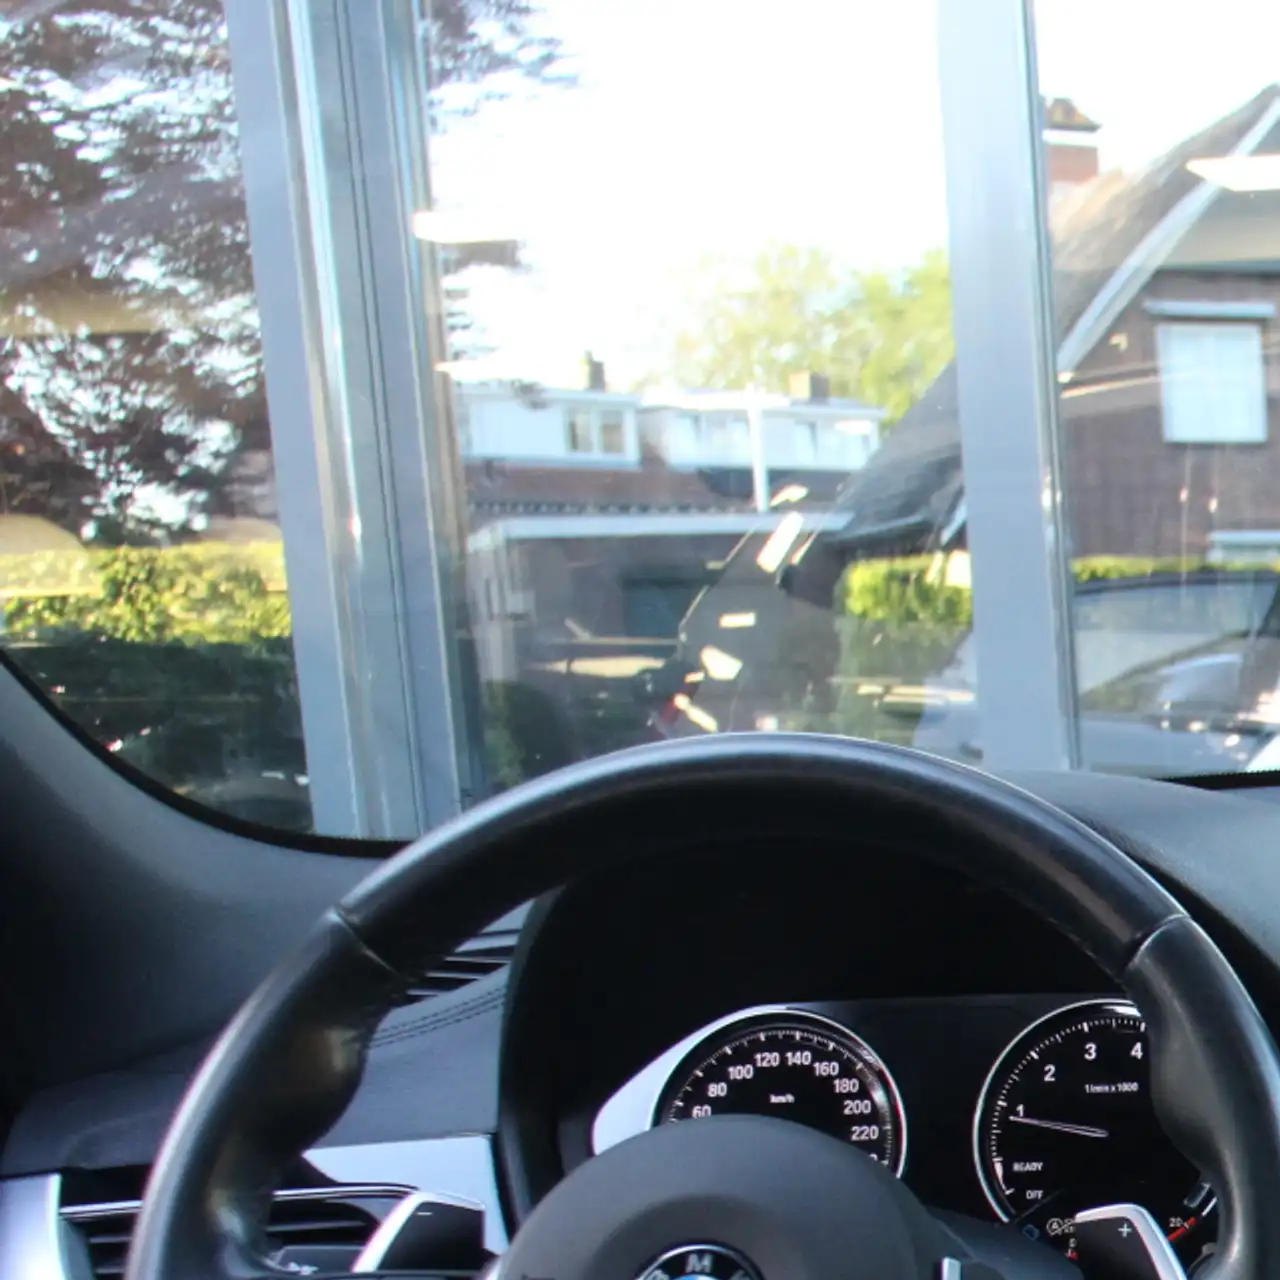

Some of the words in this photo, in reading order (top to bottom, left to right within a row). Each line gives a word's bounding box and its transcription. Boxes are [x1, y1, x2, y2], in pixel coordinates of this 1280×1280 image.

[754, 1051, 781, 1068] 120
[784, 1050, 812, 1067] 140
[1083, 1042, 1098, 1061] 3
[1130, 1042, 1144, 1060] 4
[728, 1063, 754, 1081] 100
[813, 1061, 839, 1077] 160
[1043, 1064, 1056, 1082] 2
[707, 1081, 728, 1098] 80
[834, 1078, 860, 1094] 180
[691, 1104, 711, 1118] 60
[843, 1099, 872, 1115] 200
[1016, 1103, 1025, 1117] 1
[850, 1125, 879, 1142] 220
[1012, 1161, 1043, 1172] READY
[1025, 1189, 1044, 1200] OFF
